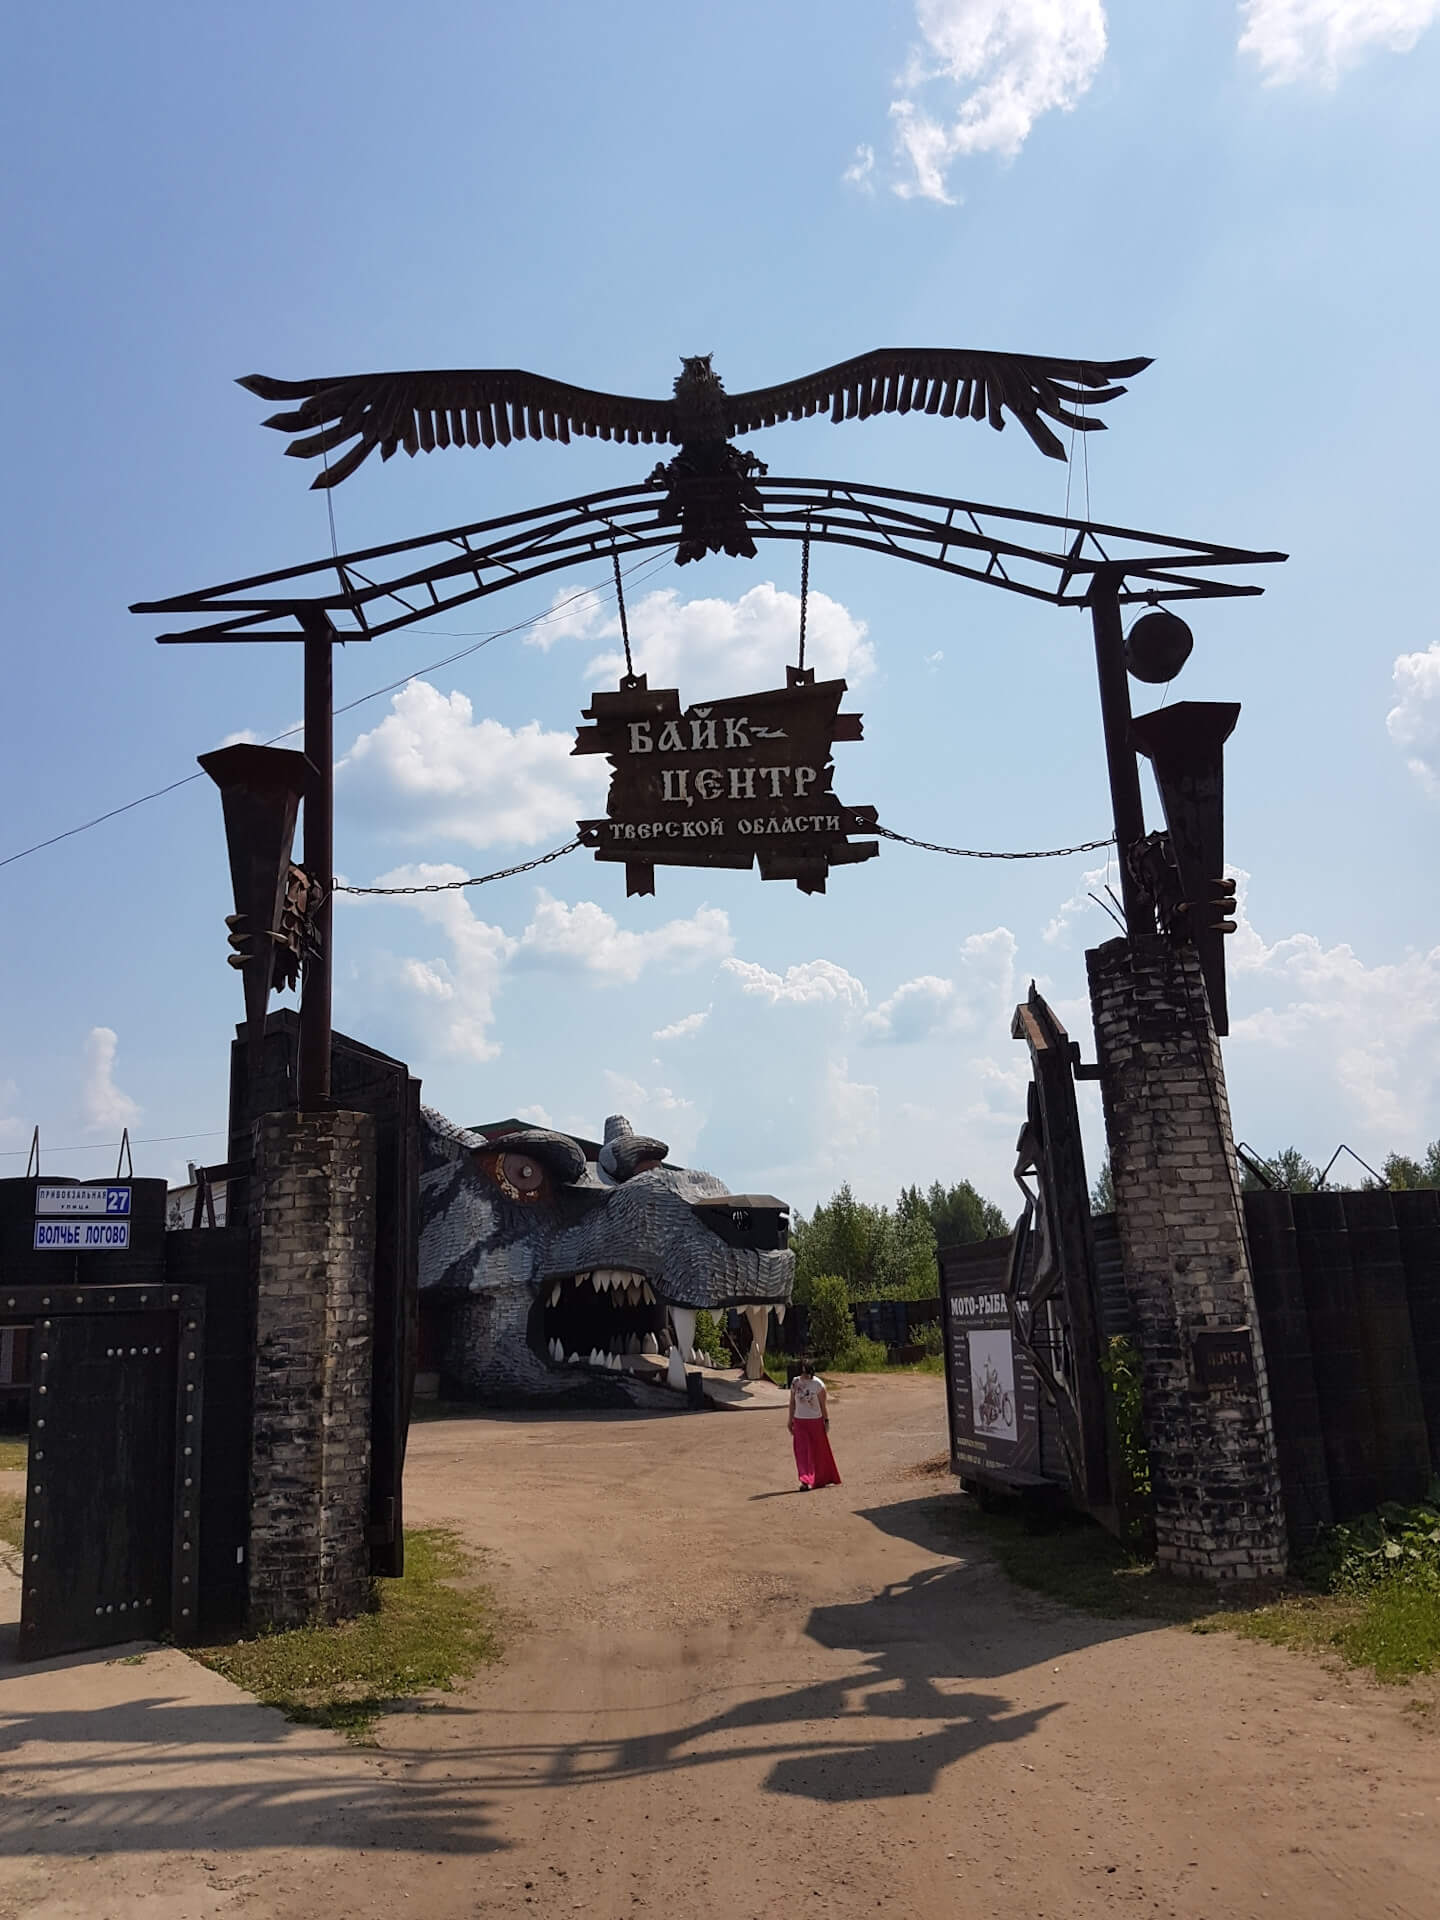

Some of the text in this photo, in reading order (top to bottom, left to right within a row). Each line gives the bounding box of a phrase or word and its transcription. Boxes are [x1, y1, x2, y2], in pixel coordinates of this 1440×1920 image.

[661, 766, 816, 808] ЦЕНТР
[609, 815, 840, 840] ТВЕРСКОЙ ОБЛАСТИ
[40, 1190, 106, 1199] ПРИВОКЗАЛЬНАЯ
[107, 1191, 128, 1210] 27
[39, 1226, 126, 1243] ВОЛЧЬЕ ЛОГОВО
